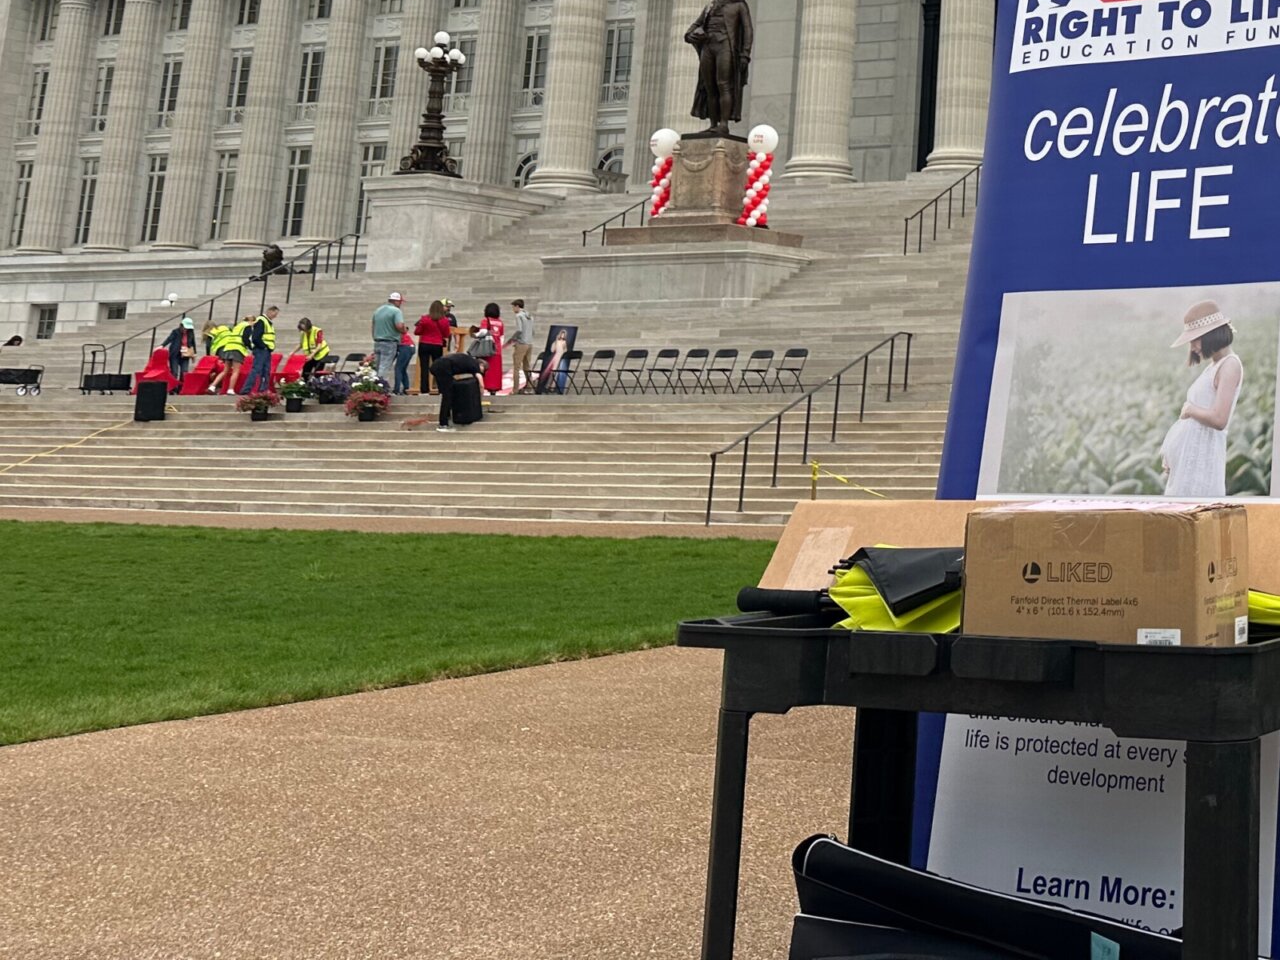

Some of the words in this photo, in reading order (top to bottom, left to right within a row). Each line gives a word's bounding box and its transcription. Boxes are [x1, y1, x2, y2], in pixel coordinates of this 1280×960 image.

[1022, 4, 1142, 46] RIGHT
[1022, 34, 1198, 64] EDUCATION
[1083, 165, 1233, 244] LIFE
[1047, 562, 1112, 582] LIKED
[1010, 596, 1039, 606] Fanfold
[1041, 597, 1064, 606] Direct
[1067, 597, 1098, 607] Thermal
[1101, 597, 1122, 607] Label
[1123, 597, 1138, 607] 4x6
[1047, 607, 1074, 617] (101.6
[1075, 608, 1081, 616] x
[1082, 607, 1124, 618] 152.4mm)
[964, 729, 990, 749] life
[995, 731, 1009, 750] is
[1014, 736, 1099, 758] protected
[1103, 741, 1121, 760] at
[1126, 745, 1178, 768] every
[1047, 765, 1165, 793] development
[1016, 867, 1090, 900] Learn
[1099, 875, 1175, 910] More:
